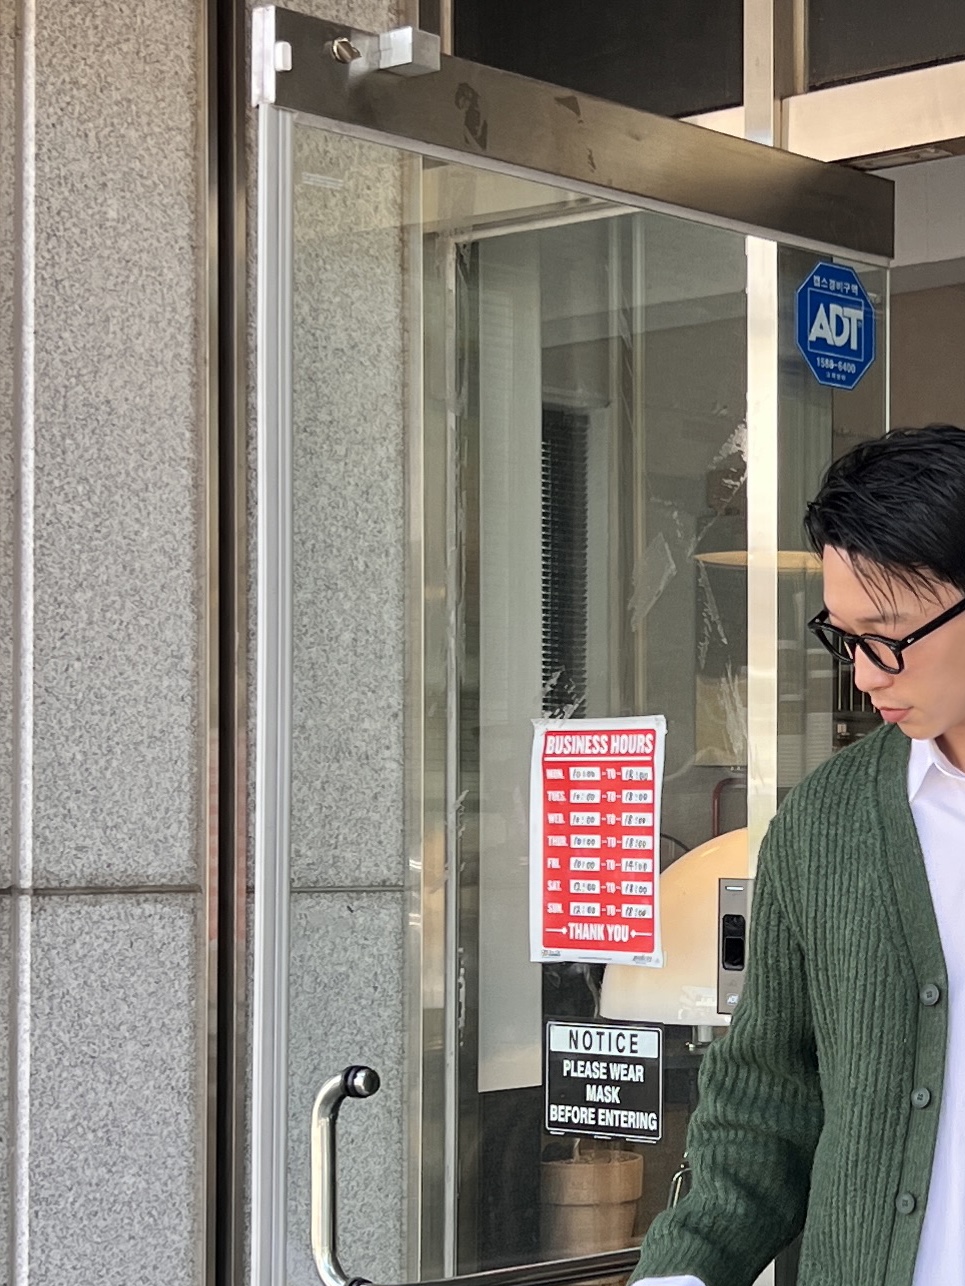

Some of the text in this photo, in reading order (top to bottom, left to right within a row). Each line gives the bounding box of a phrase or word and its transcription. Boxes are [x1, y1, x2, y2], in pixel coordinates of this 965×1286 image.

[808, 303, 864, 351] ADT
[816, 356, 857, 374] 1588-6400
[546, 734, 654, 755] BUSINESS HOURS
[568, 922, 630, 943] THANK YOU
[569, 1029, 639, 1054] NOTICE
[563, 1059, 645, 1082] PLEASE WEAR
[585, 1084, 621, 1104] MASK
[549, 1104, 658, 1131] BEFORE ENTERING
